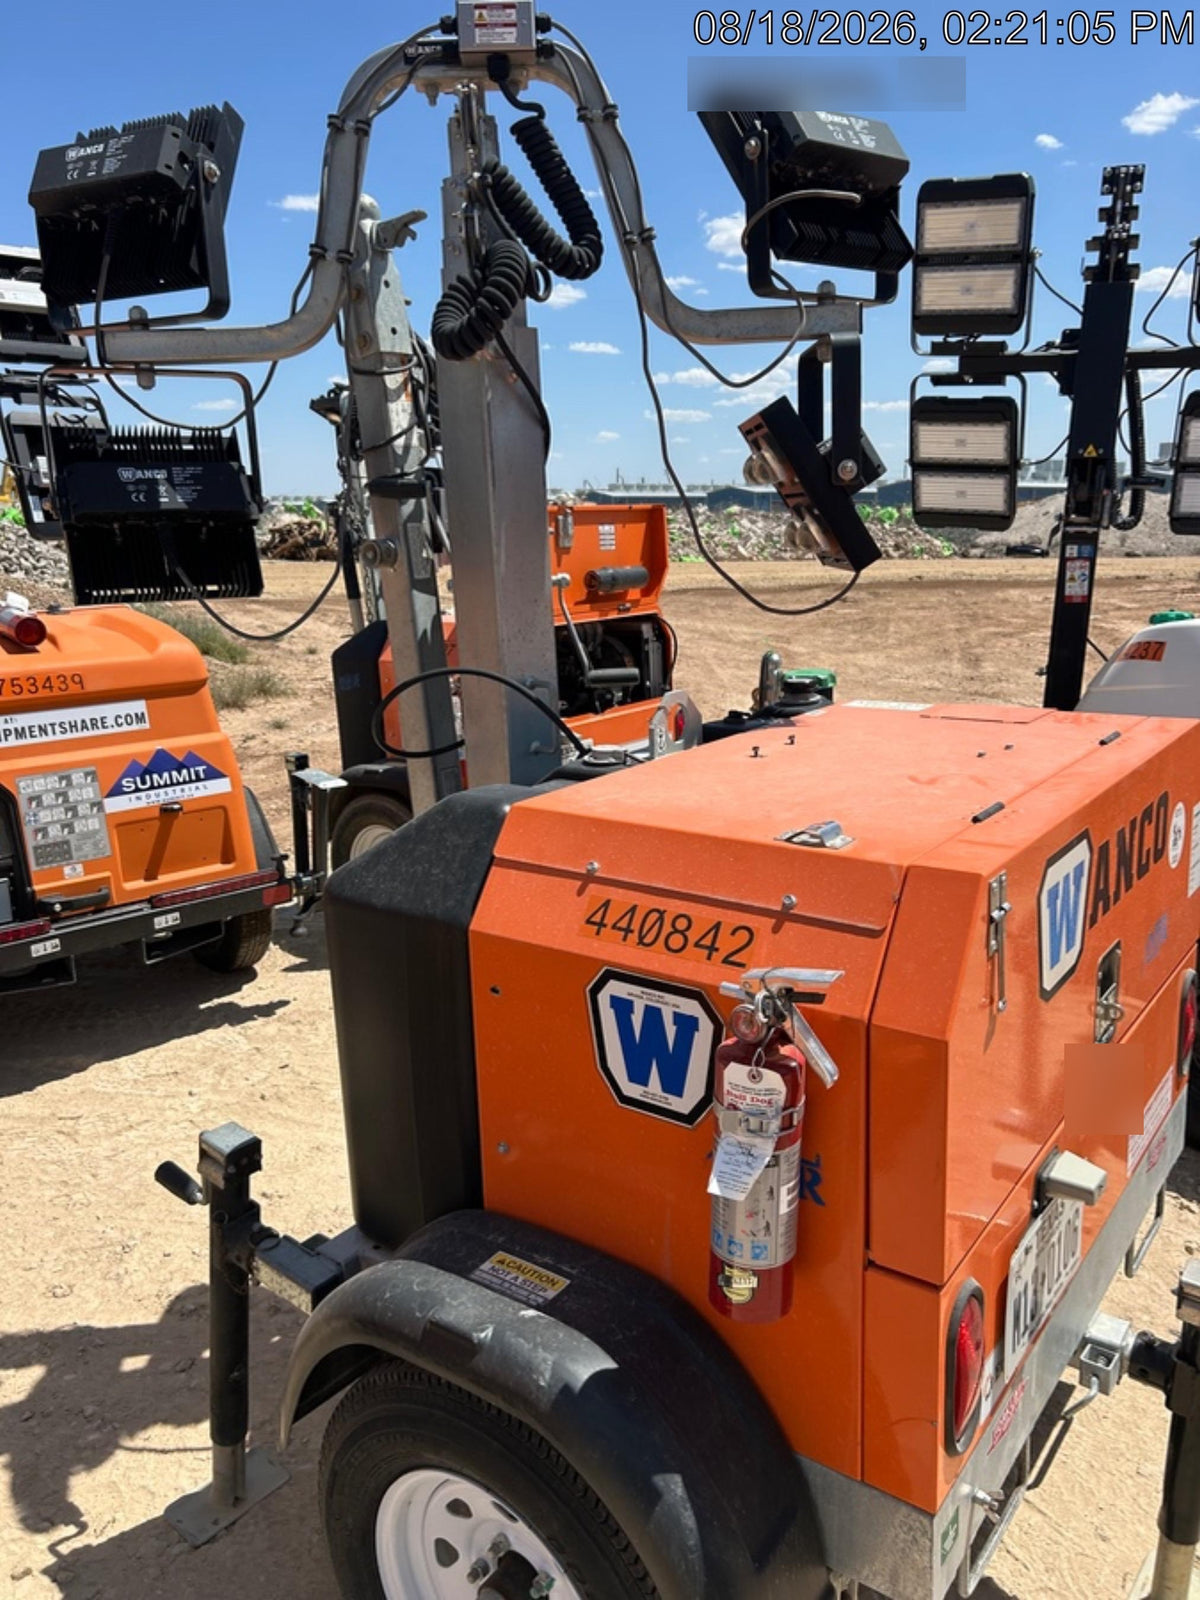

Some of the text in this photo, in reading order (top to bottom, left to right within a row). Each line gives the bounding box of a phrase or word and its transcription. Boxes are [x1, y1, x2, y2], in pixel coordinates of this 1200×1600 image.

[65, 144, 104, 162] WANCO
[117, 467, 167, 482] WANCO
[122, 765, 207, 792] SUMMIT
[128, 784, 208, 803] INDUSTRIAL
[584, 898, 755, 968] 440842
[609, 994, 699, 1099] W
[505, 1258, 559, 1288] CAUTION
